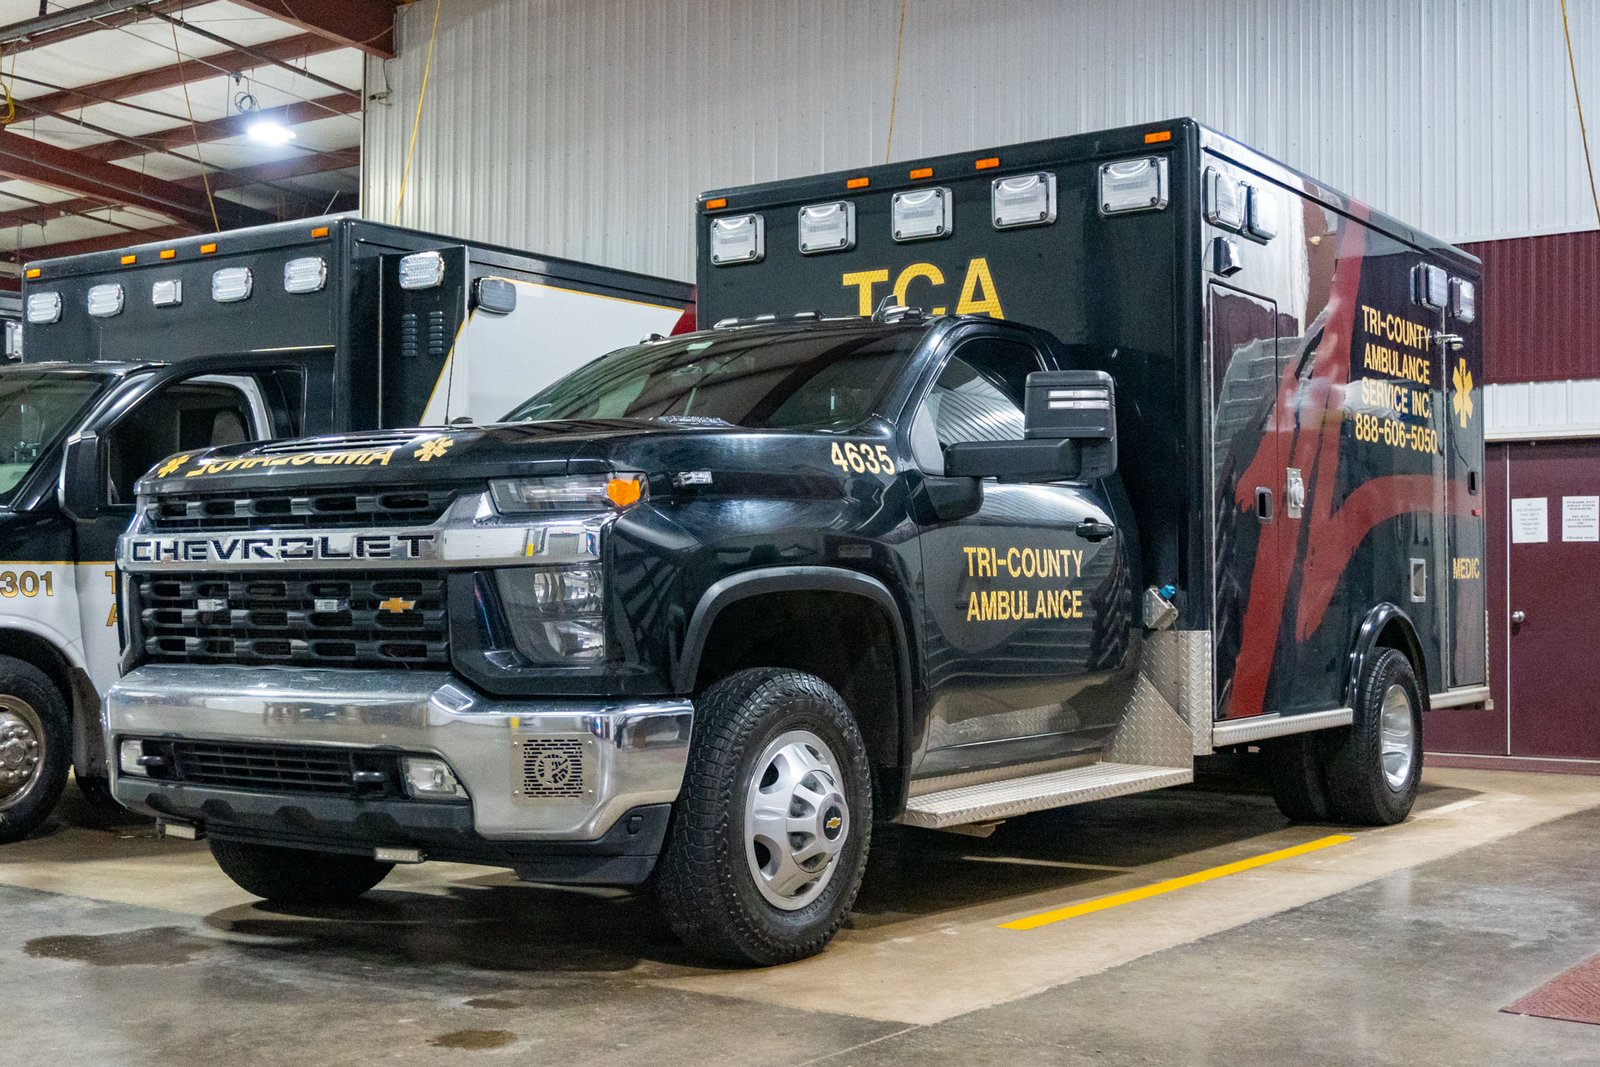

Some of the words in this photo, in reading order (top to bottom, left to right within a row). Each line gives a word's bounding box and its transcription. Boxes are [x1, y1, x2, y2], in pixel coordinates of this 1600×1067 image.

[842, 257, 1005, 320] TCA
[1362, 304, 1431, 352] TRI-COUNTY
[1363, 342, 1430, 385] AMBULANCE
[1361, 376, 1409, 414] SERVICE
[1411, 390, 1432, 419] INC.
[1355, 412, 1438, 455] 888-606-5050
[831, 442, 896, 475] 4635
[131, 534, 437, 562] CHEVROLET
[963, 546, 1083, 578] TRI-COUNTY
[0, 570, 54, 598] 301
[1452, 557, 1480, 579] MEDIC
[967, 589, 1083, 622] AMBULANCE
